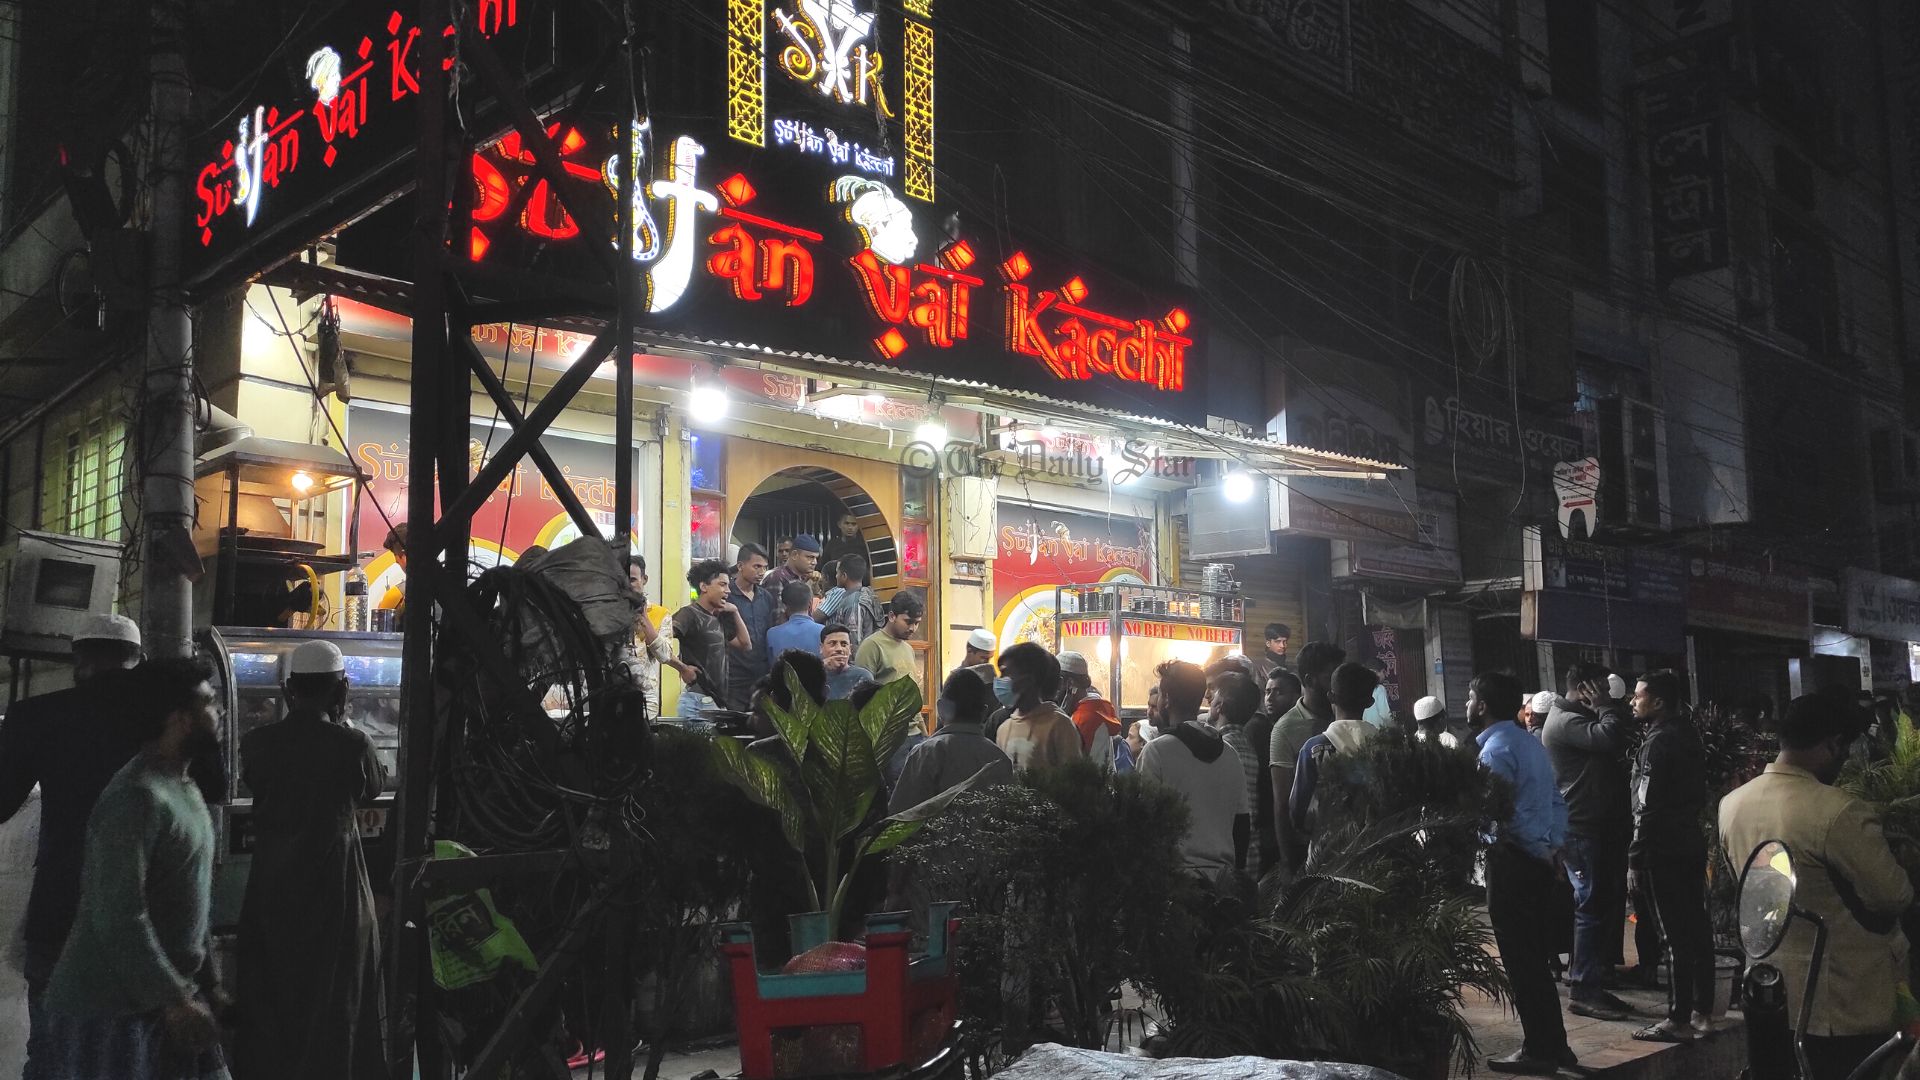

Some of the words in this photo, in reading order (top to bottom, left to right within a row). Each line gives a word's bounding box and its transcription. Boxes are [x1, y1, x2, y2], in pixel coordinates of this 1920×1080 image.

[848, 240, 984, 360] Vai
[1003, 250, 1194, 393] Kacchi
[1001, 519, 1059, 566] Sultan
[1060, 537, 1090, 565] Vai
[1064, 621, 1079, 636] NO
[1081, 620, 1109, 637] BEEF
[1123, 620, 1142, 637] NO
[1144, 622, 1177, 639] BEEF
[1187, 625, 1203, 641] NO
[1205, 628, 1236, 644] BEEF
